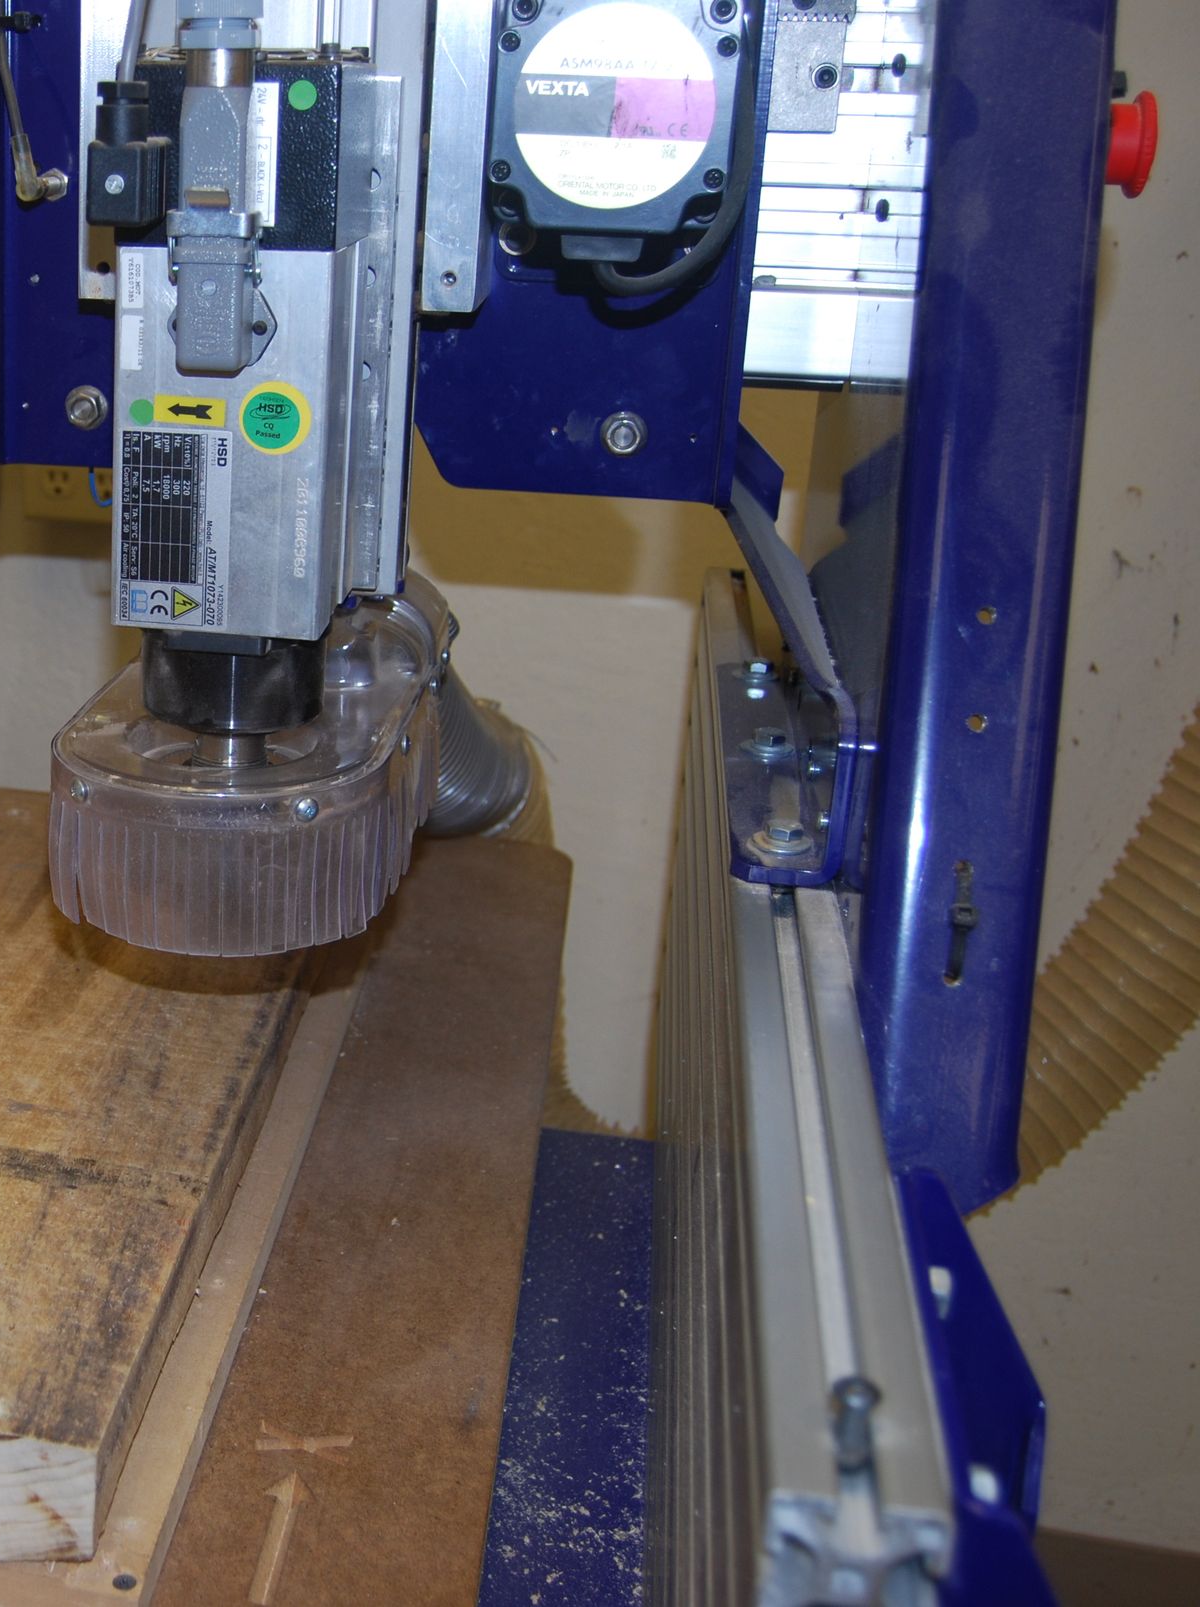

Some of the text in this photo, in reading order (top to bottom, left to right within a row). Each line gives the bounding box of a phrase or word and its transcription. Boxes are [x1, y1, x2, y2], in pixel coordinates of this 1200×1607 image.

[525, 79, 589, 97] VEXTA
[596, 182, 625, 190] MOTOR
[257, 403, 284, 414] HSD
[255, 430, 281, 439] Passed
[263, 422, 274, 430] CQ
[143, 433, 151, 441] A
[153, 434, 161, 449] kW
[217, 437, 228, 467] HSD
[162, 434, 171, 500] rpm 18000
[172, 435, 182, 496] Hz 300
[182, 479, 190, 496] 220
[121, 542, 130, 578] Air cooling
[205, 520, 217, 626] Model: AT/MT1073-070
